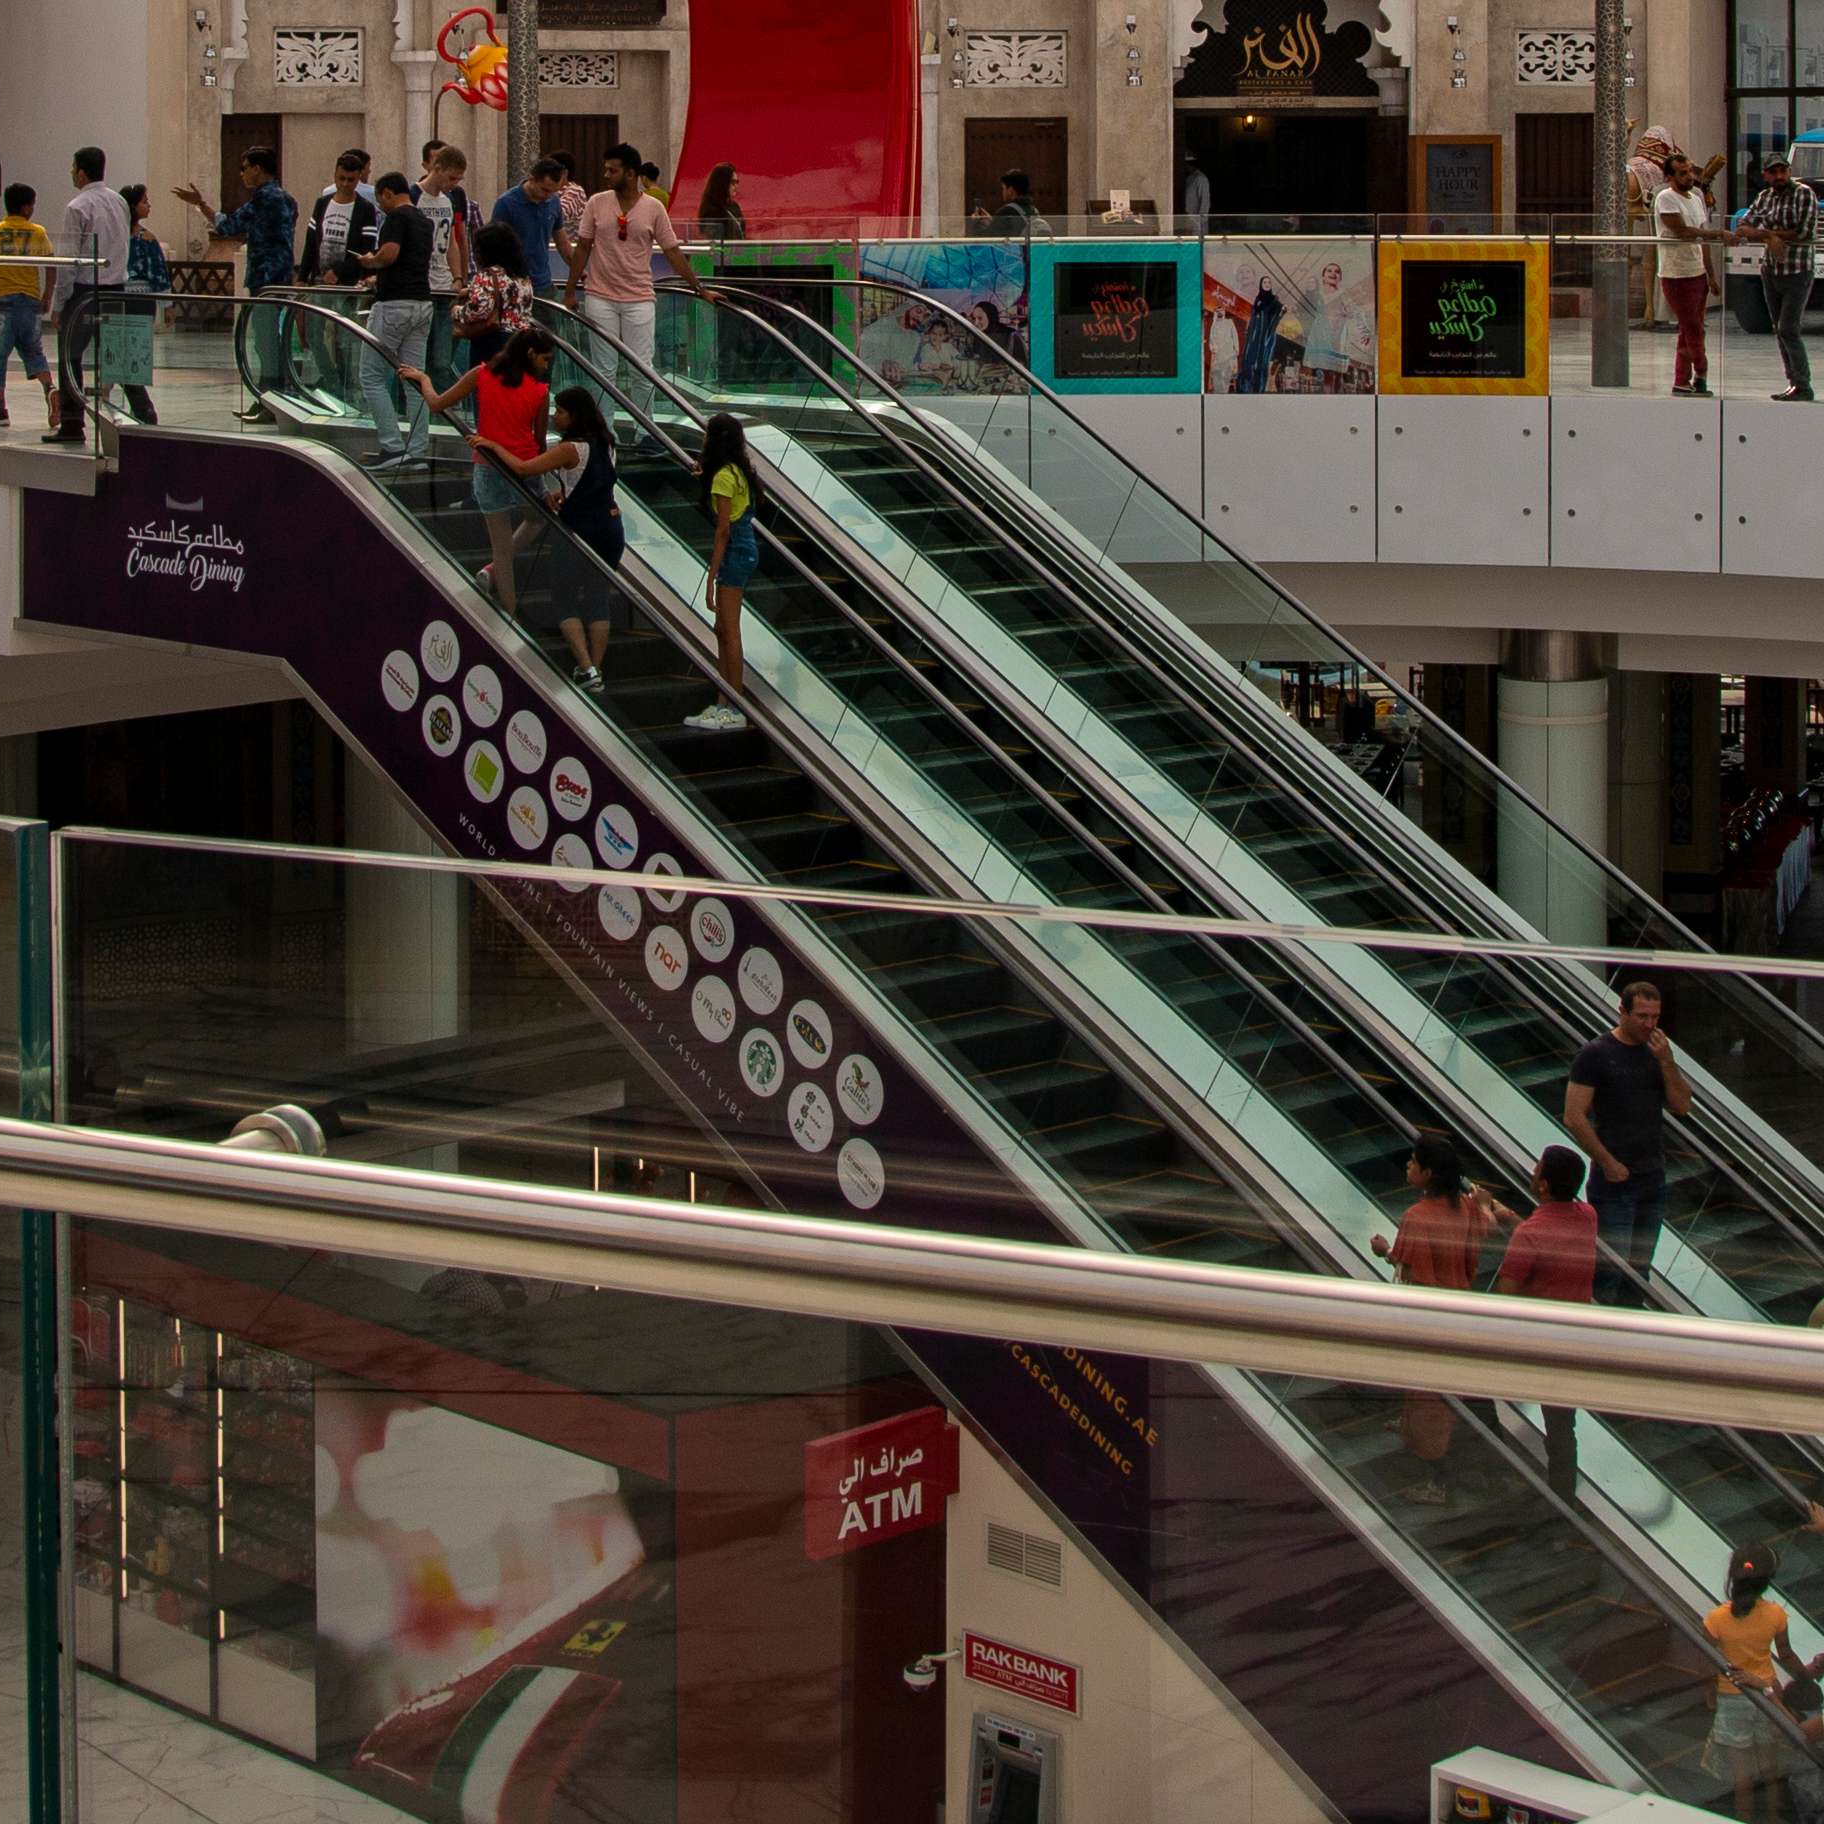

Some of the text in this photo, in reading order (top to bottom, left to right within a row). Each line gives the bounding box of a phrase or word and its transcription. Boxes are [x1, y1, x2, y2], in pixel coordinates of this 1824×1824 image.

[1232, 12, 1320, 78] الفنر
[1436, 165, 1481, 178] HAPPY
[1439, 178, 1480, 191] HOUR
[127, 519, 245, 560] مطاعم كاسكيد
[127, 547, 246, 593] Cascade Dining
[458, 810, 497, 857] WORLD
[556, 914, 617, 980] FOUNTAIN
[617, 979, 656, 1022] VIEWS
[667, 1033, 713, 1089] CASUAL
[716, 1087, 746, 1123] VIBE
[654, 941, 682, 974] nar
[1010, 1342, 1135, 1479] CASCADEDINING
[838, 1446, 924, 1504] صراف الي
[837, 1481, 923, 1540] ATM
[971, 1641, 1069, 1688] RAKBANK
